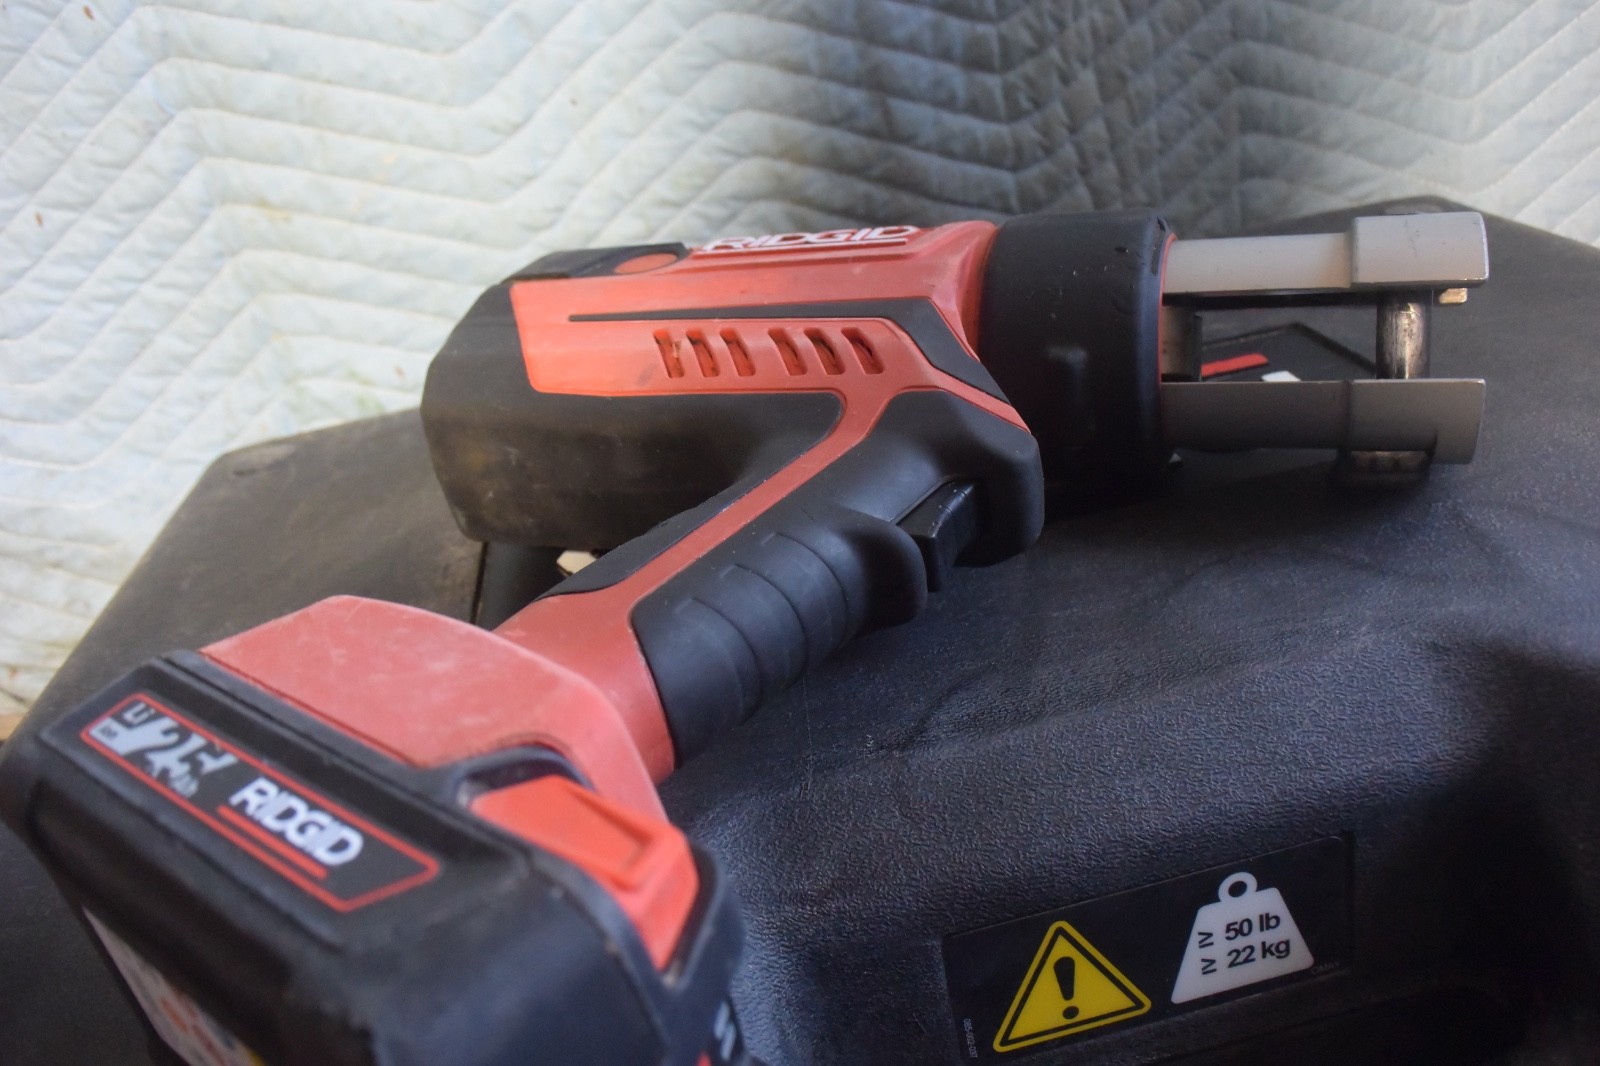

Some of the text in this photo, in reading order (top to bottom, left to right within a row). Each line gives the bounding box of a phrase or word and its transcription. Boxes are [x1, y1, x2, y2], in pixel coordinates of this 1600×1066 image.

[702, 225, 920, 251] RIDGID
[228, 776, 364, 866] RIDGID
[1224, 918, 1253, 941] 50
[1258, 912, 1281, 932] lb
[1227, 945, 1257, 968] 22
[1260, 939, 1291, 960] kg
